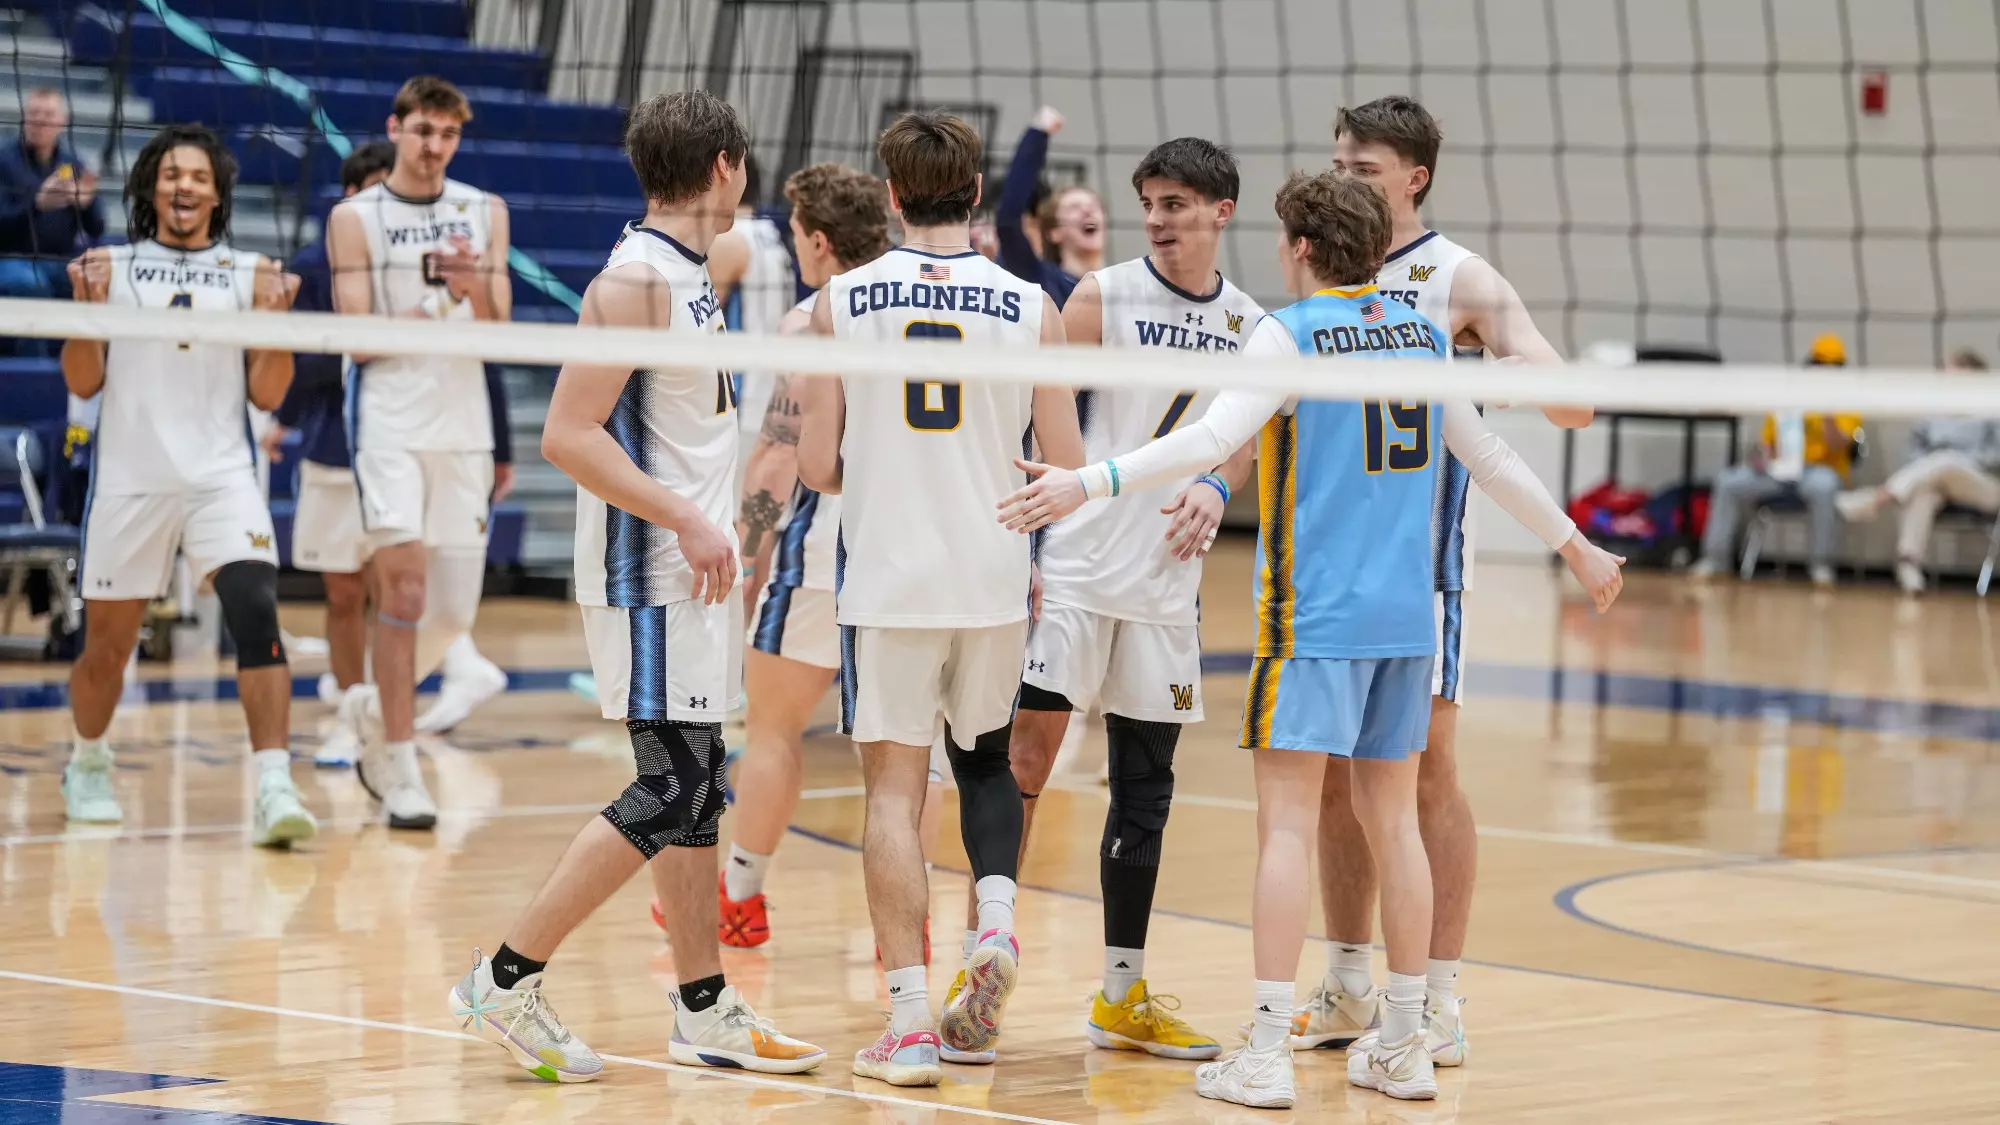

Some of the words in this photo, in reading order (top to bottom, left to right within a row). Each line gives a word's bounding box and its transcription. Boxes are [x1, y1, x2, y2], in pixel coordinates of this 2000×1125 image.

[134, 266, 231, 290] WILKES
[1409, 264, 1437, 281] W
[849, 281, 1021, 323] COLONELS
[1225, 310, 1244, 334] W
[1312, 320, 1436, 357] COLONELS
[1170, 684, 1193, 710] W
